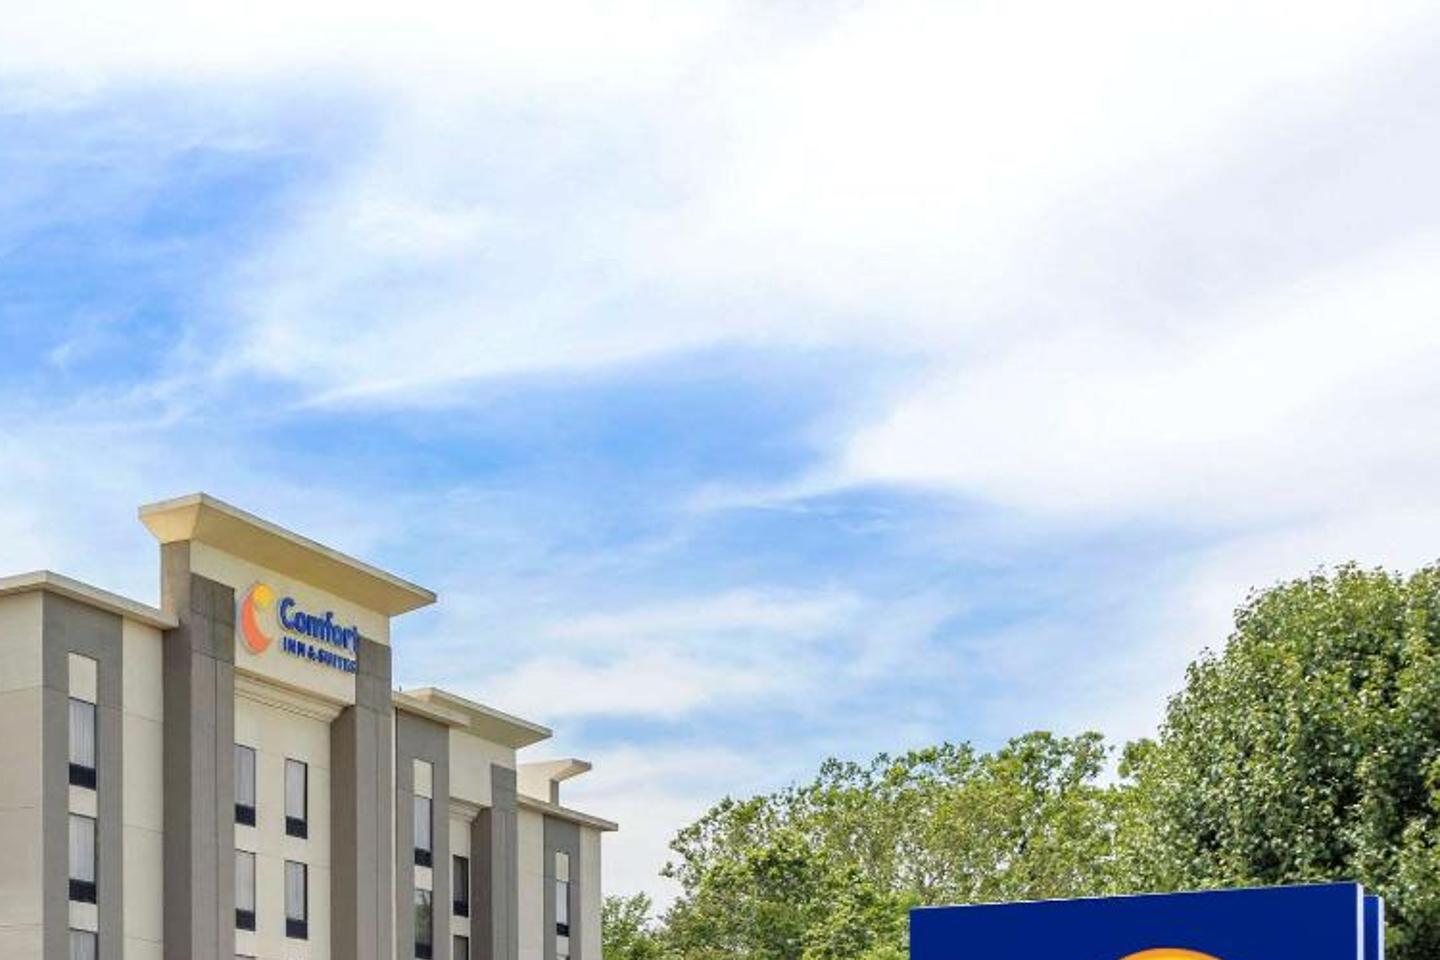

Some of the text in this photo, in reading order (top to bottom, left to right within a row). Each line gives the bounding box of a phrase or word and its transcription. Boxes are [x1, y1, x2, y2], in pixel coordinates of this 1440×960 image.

[280, 597, 358, 651] Comfort
[283, 636, 306, 657] INN
[318, 649, 357, 673] SUITES
